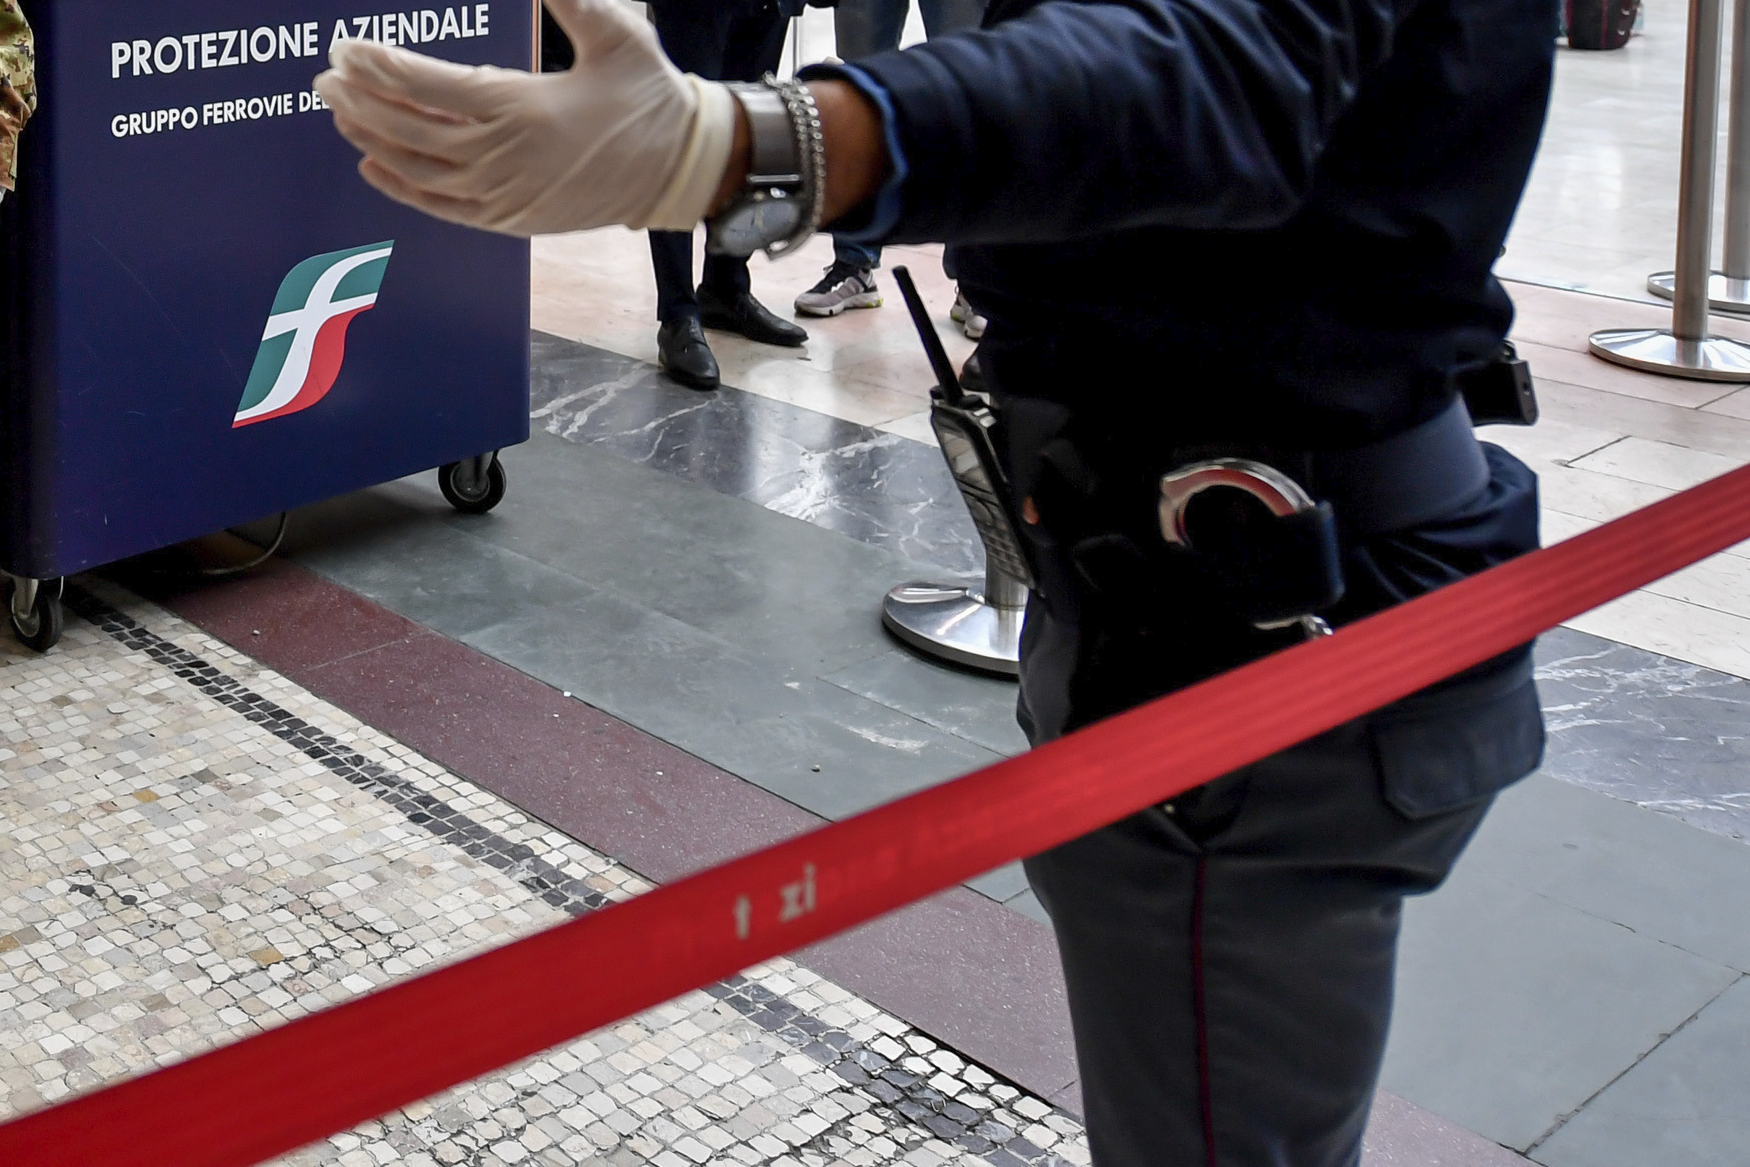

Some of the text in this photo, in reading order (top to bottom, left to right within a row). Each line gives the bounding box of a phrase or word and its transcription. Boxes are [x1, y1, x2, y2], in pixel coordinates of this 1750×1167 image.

[111, 3, 489, 79] PROTEZIONE AZIENDALE
[111, 105, 199, 138] GRUPPO
[202, 92, 293, 126] FERROVIE
